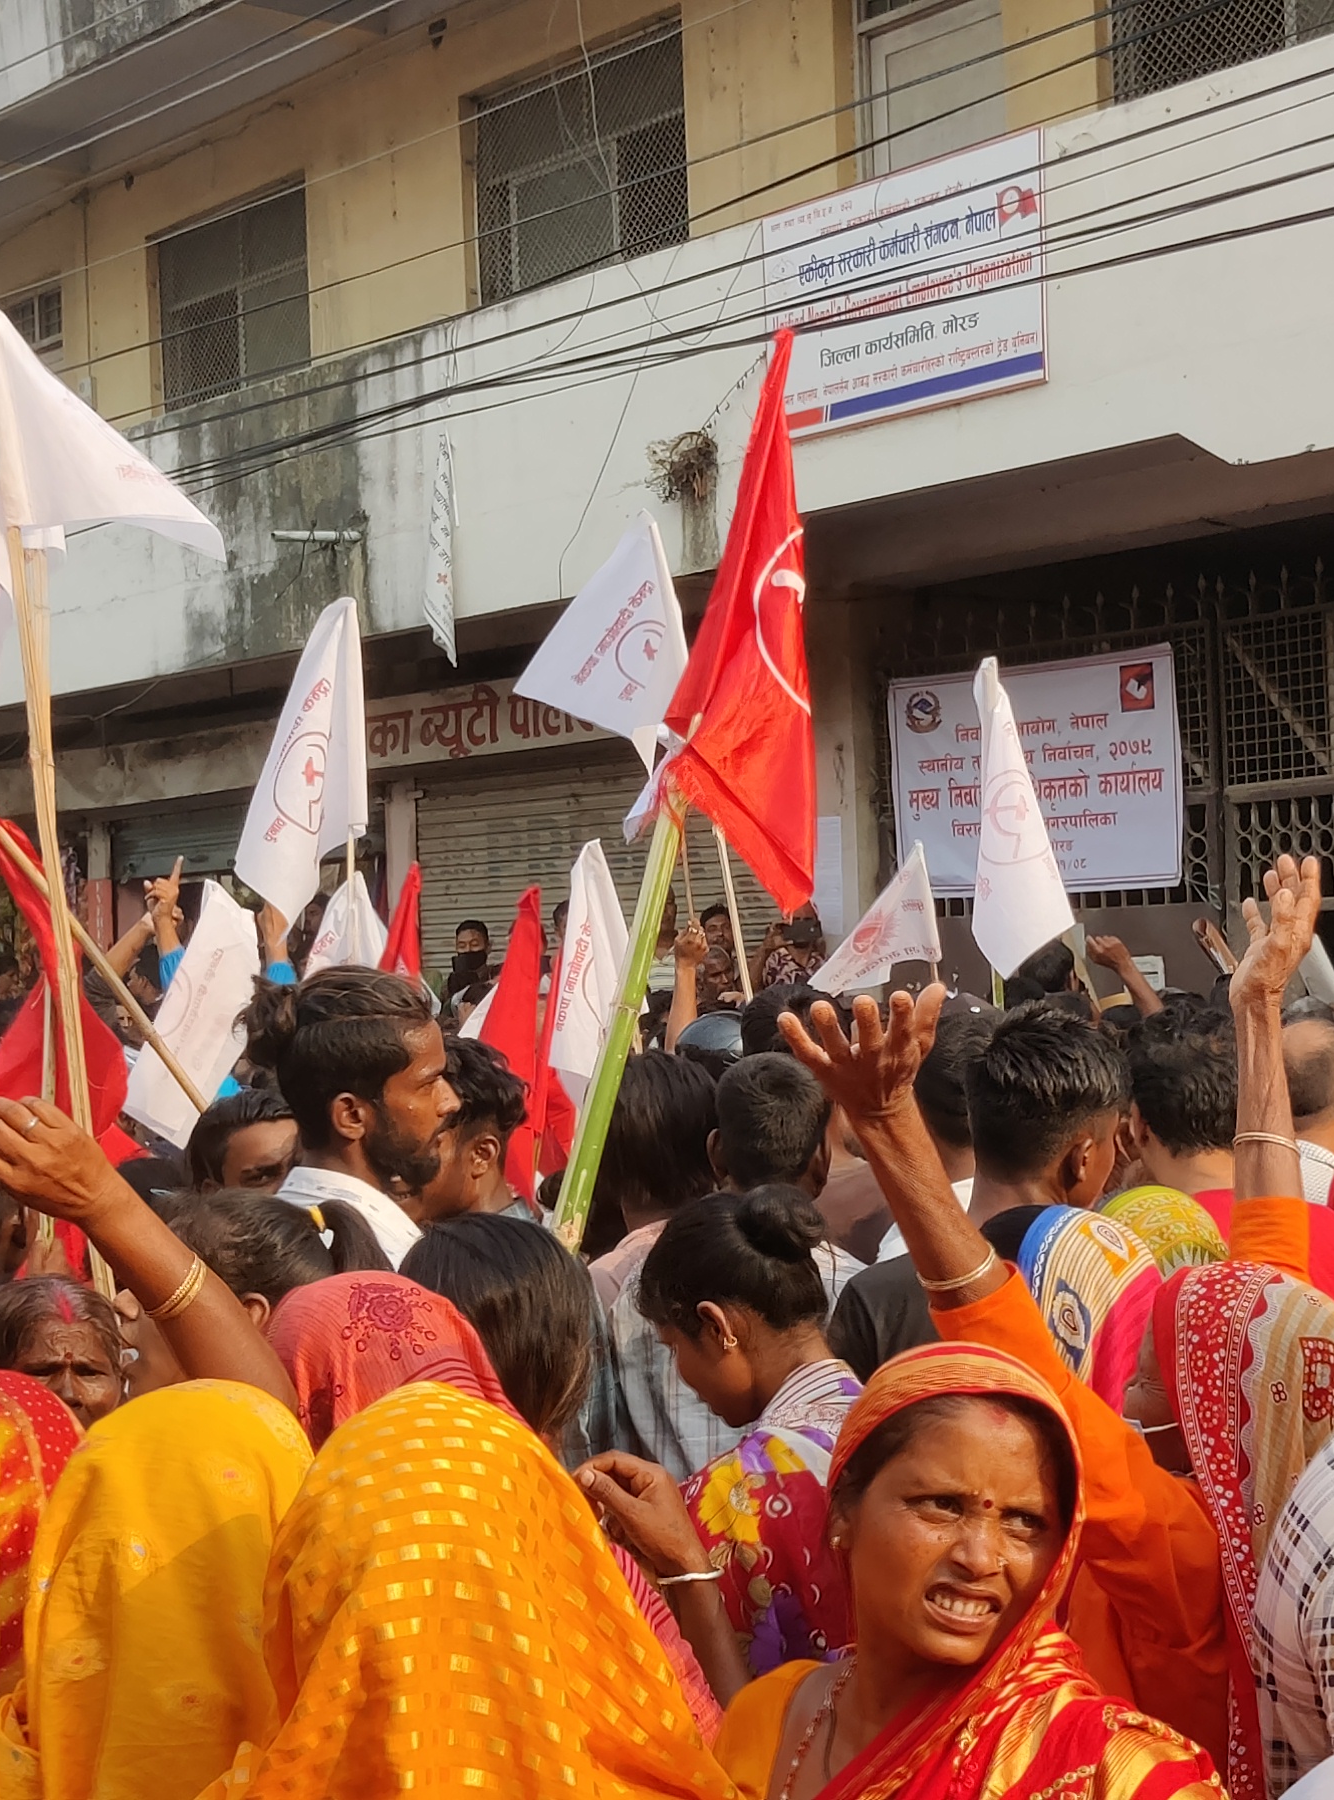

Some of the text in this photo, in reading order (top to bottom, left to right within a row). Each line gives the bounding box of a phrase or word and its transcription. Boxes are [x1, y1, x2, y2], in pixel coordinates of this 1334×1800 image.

[837, 235, 877, 276] सरकारी
[879, 223, 921, 260] कर्मचारी
[965, 205, 997, 239] नेपाल
[965, 246, 1033, 292] Organization
[820, 343, 860, 368] जिल्ला
[942, 311, 980, 337] मोरङ
[1069, 712, 1109, 734] नेपाल
[918, 752, 965, 776] स्थानीय
[1109, 736, 1152, 761] २०७९
[909, 787, 941, 822] मुख्य
[1097, 760, 1165, 796] कार्यालय
